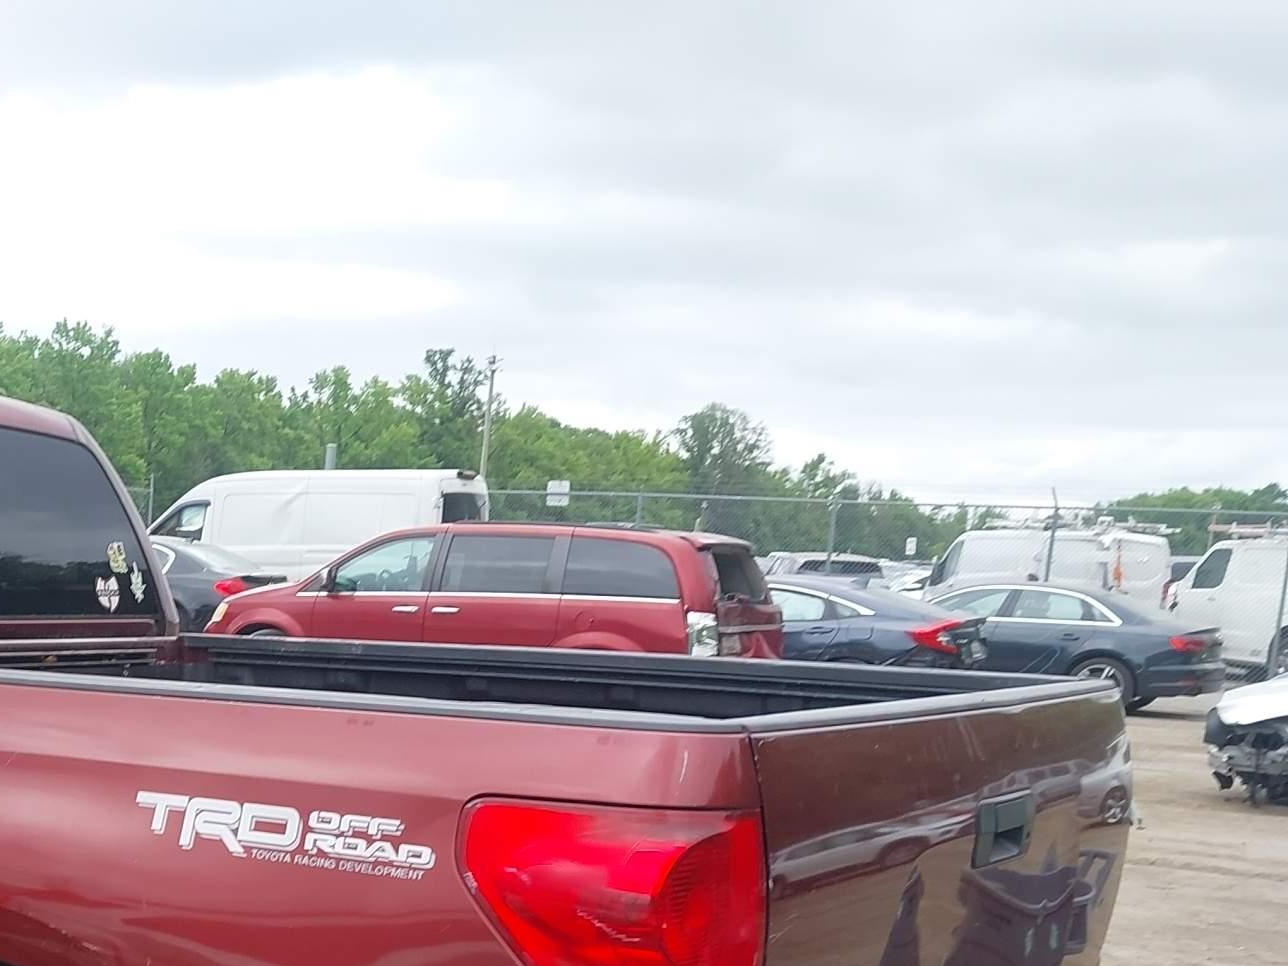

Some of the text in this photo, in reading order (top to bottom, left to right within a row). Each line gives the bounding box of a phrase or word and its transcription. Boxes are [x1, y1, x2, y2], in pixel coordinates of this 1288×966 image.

[136, 790, 303, 858] TRD
[308, 810, 406, 839] OFF
[251, 849, 425, 881] TOYOTA RACING DEVELOPMENT
[304, 832, 437, 870] ROAD
